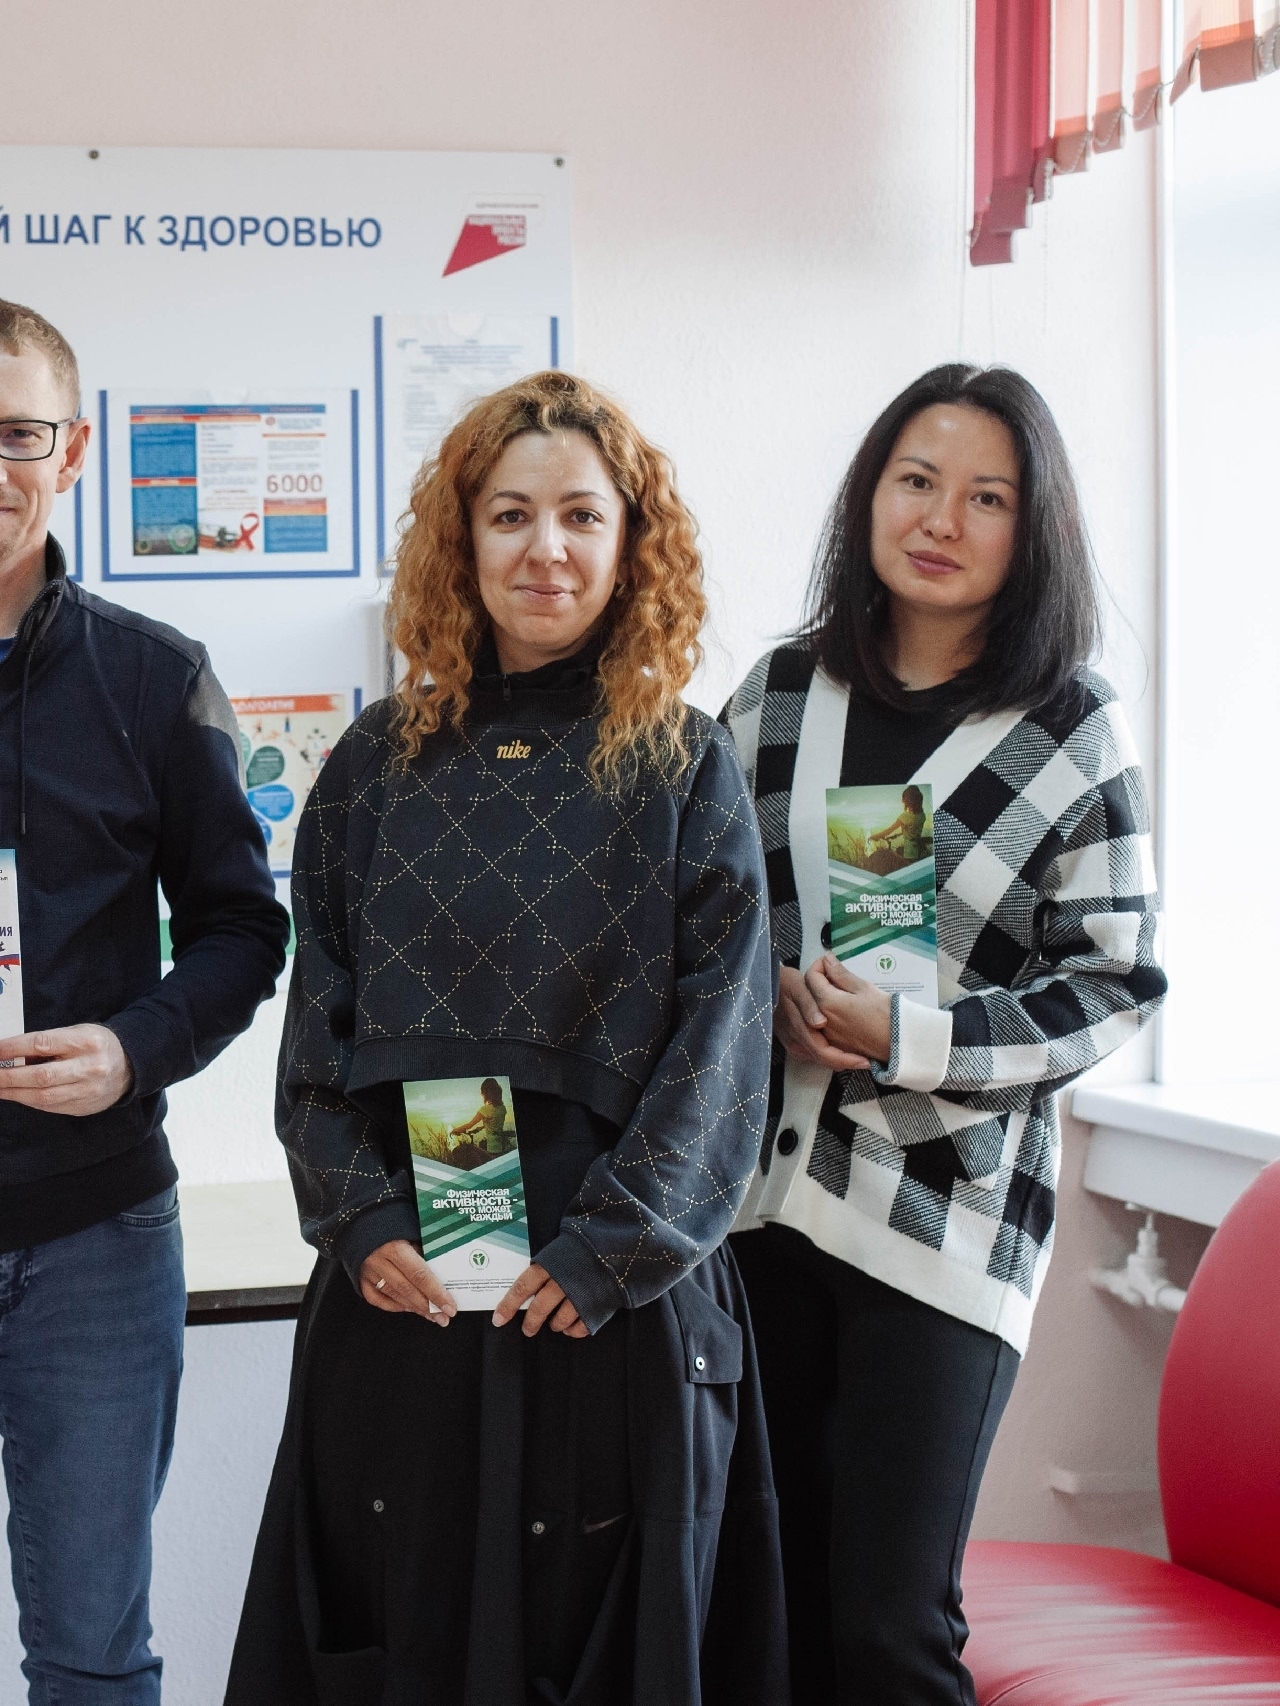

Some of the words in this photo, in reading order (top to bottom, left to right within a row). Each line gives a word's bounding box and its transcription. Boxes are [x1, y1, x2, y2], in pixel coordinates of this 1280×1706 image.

[25, 214, 111, 246] ШАГ
[125, 215, 146, 246] К
[158, 216, 382, 251] ЗДОРОВЬЮ
[266, 474, 323, 493] 6000
[496, 739, 532, 759] nike
[860, 893, 922, 902] Физическая
[870, 911, 888, 919] это
[889, 910, 923, 919] может
[880, 918, 923, 927] каждый
[446, 1188, 510, 1198] Физическая
[458, 1207, 476, 1215] это
[477, 1204, 512, 1214] может
[470, 1213, 513, 1222] каждый
